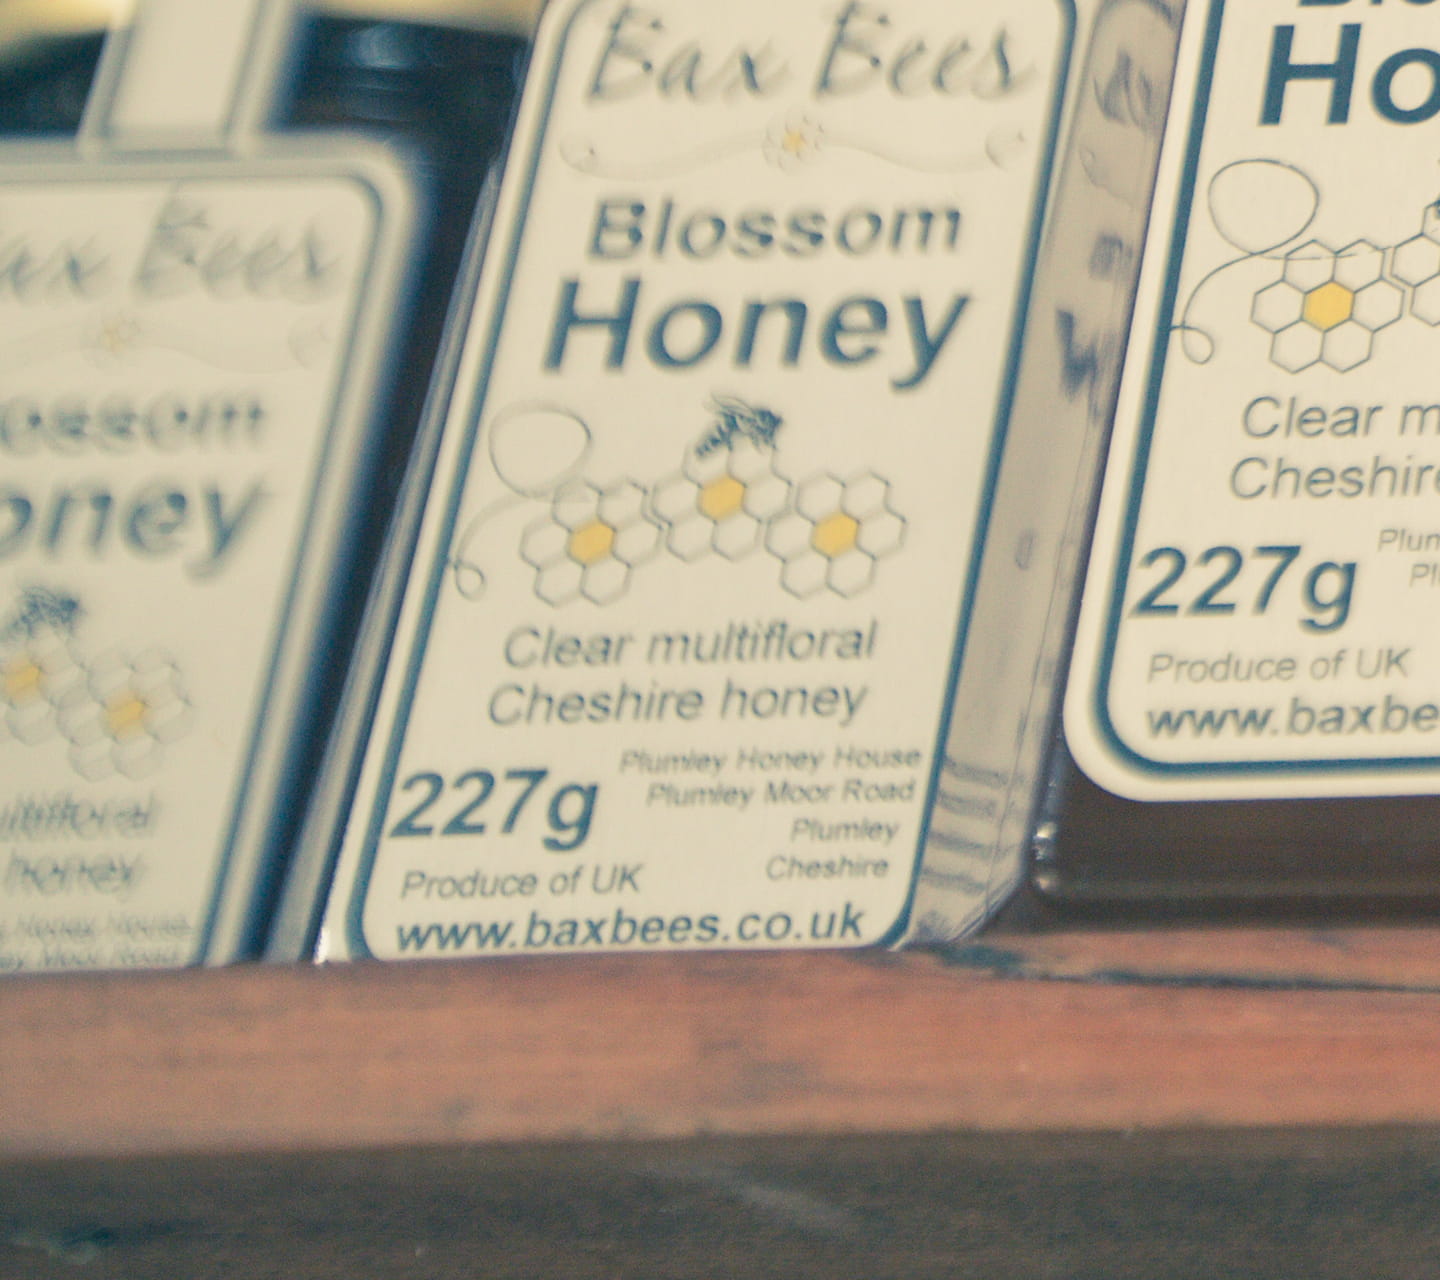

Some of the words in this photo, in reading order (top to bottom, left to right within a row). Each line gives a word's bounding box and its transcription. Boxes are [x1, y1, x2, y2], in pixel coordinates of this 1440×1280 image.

[583, 0, 786, 105] Bax
[587, 197, 962, 261] Blossom
[543, 276, 971, 392] Honey
[1242, 395, 1384, 439] Clear
[1131, 544, 1358, 634] 227g
[504, 626, 633, 668] Clear
[647, 619, 878, 663] multifloral
[1148, 652, 1298, 683] Produce
[1310, 648, 1348, 680] of
[1357, 647, 1410, 678] UK
[720, 678, 868, 727] honey
[389, 767, 600, 852] 227g
[397, 902, 864, 953] www.baxbees.co.uk
